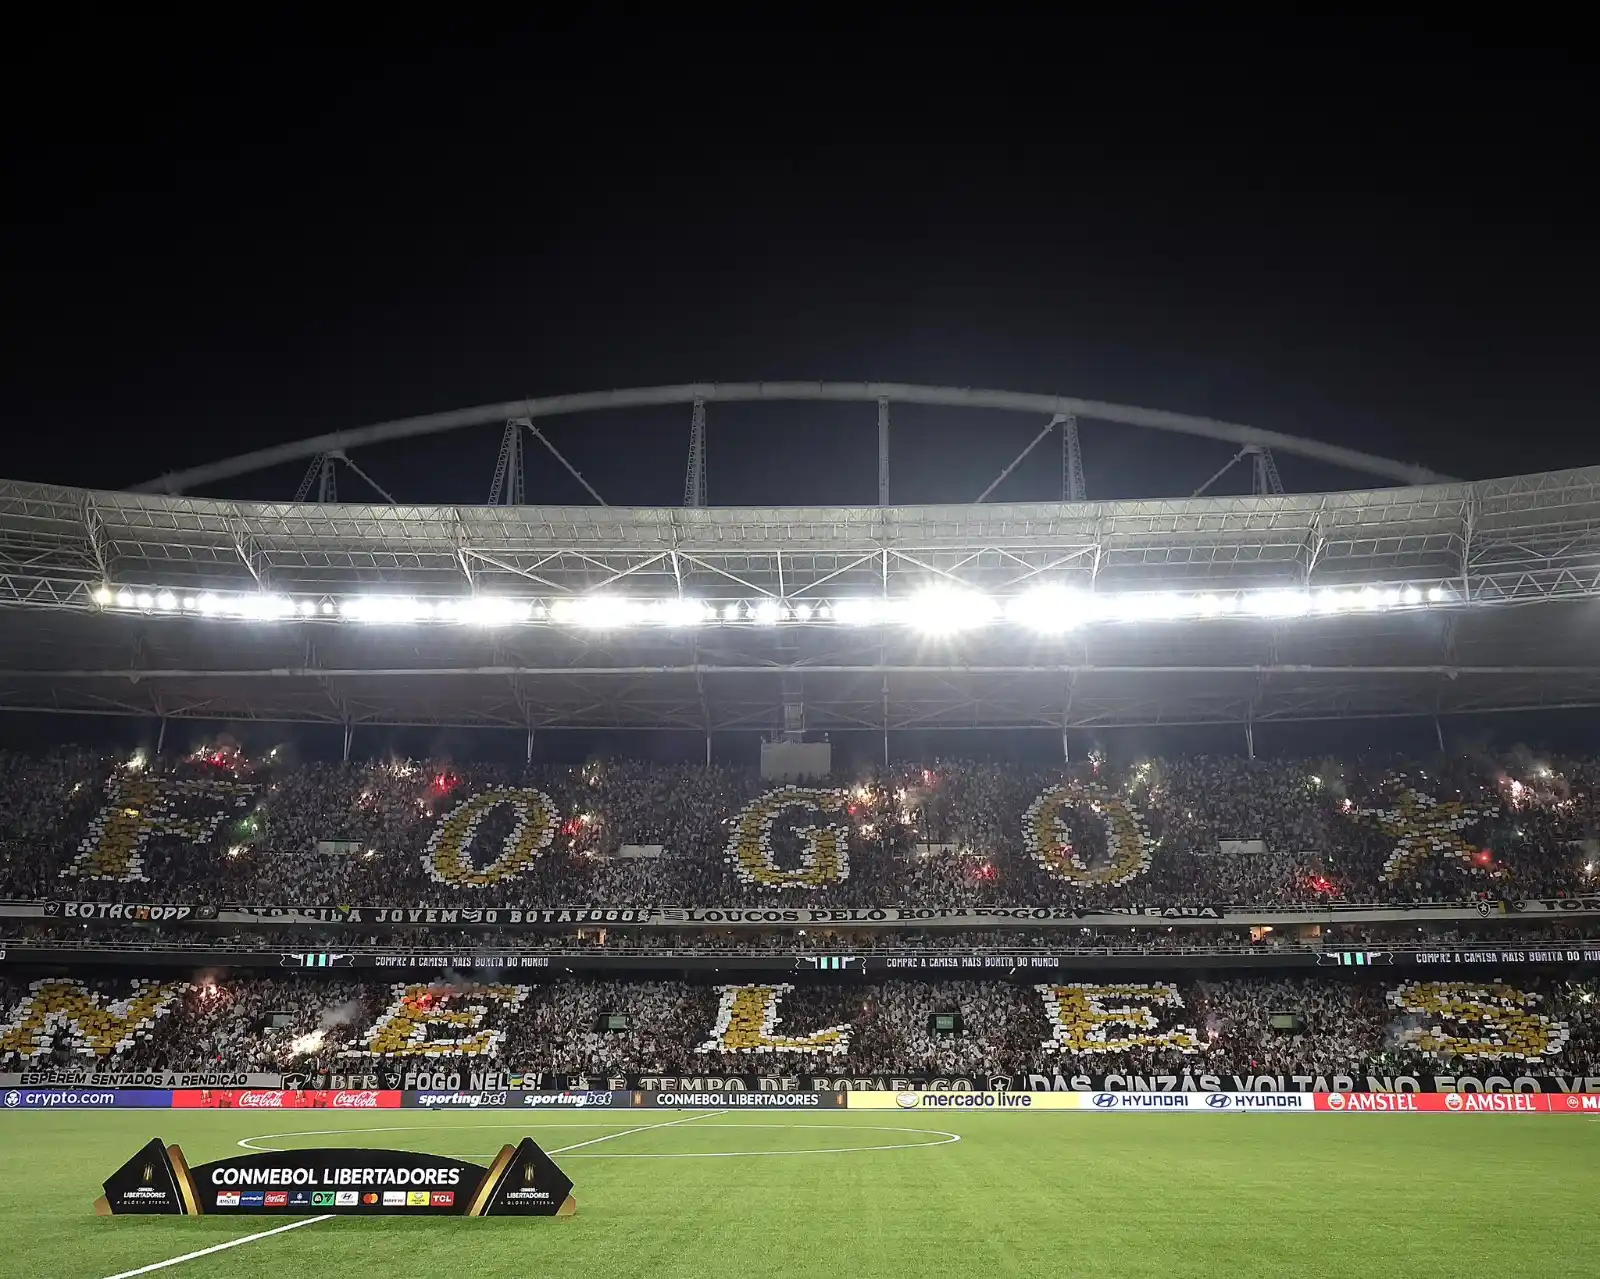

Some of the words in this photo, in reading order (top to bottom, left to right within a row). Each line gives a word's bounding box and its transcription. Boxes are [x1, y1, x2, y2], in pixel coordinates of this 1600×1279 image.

[374, 910, 458, 922] JOVEM
[509, 910, 634, 922] BOTAFOGO
[686, 910, 799, 923] LOUCOS
[808, 909, 888, 922] PELO
[375, 957, 407, 967] COMPRE
[410, 957, 416, 967] A
[418, 957, 448, 967] CAMISA
[451, 957, 471, 967] MAIS
[507, 957, 518, 967] DO
[886, 957, 918, 967] COMPRE
[921, 957, 927, 967] A
[929, 957, 958, 967] CAMISA
[962, 957, 981, 967] MAIS
[985, 957, 1014, 967] BONITA
[1017, 957, 1028, 967] DO
[1031, 957, 1059, 967] MUNDO
[1415, 953, 1452, 963] COMPRE
[1455, 953, 1461, 963] A
[1464, 952, 1498, 963] CAMISA
[1501, 952, 1525, 962] MAIS
[1529, 951, 1563, 962] BONITA
[1567, 951, 1580, 961] DO
[20, 1073, 86, 1085] ESPEREM
[91, 1073, 164, 1085] SENTADOS
[167, 1075, 177, 1085] A
[330, 1075, 378, 1090] BFR
[403, 1073, 460, 1090] FOGO
[469, 1073, 542, 1090] NELES!
[640, 1078, 748, 1091] TEMPO
[1028, 1075, 1092, 1091] DAS
[1104, 1075, 1221, 1092] CINZAS
[1366, 1076, 1420, 1093] NO
[1434, 1076, 1541, 1093] FOGO
[25, 1092, 115, 1107] crypto.com
[418, 1092, 508, 1107] sportingbet
[523, 1092, 612, 1107] sportingbet
[656, 1093, 727, 1105] CONMEBOL
[729, 1093, 819, 1105] LIBERTADORES
[922, 1092, 994, 1107] mercado
[998, 1092, 1032, 1107] livre
[1122, 1095, 1189, 1107] HYUNDAI
[1235, 1096, 1302, 1107] HYUNDAI
[1347, 1094, 1416, 1110] AMSTEL
[1465, 1094, 1534, 1110] AMSTEL
[211, 1168, 318, 1185] CONMEBOL
[323, 1168, 460, 1185] LIBERTADORES
[433, 1196, 452, 1204] TCL
